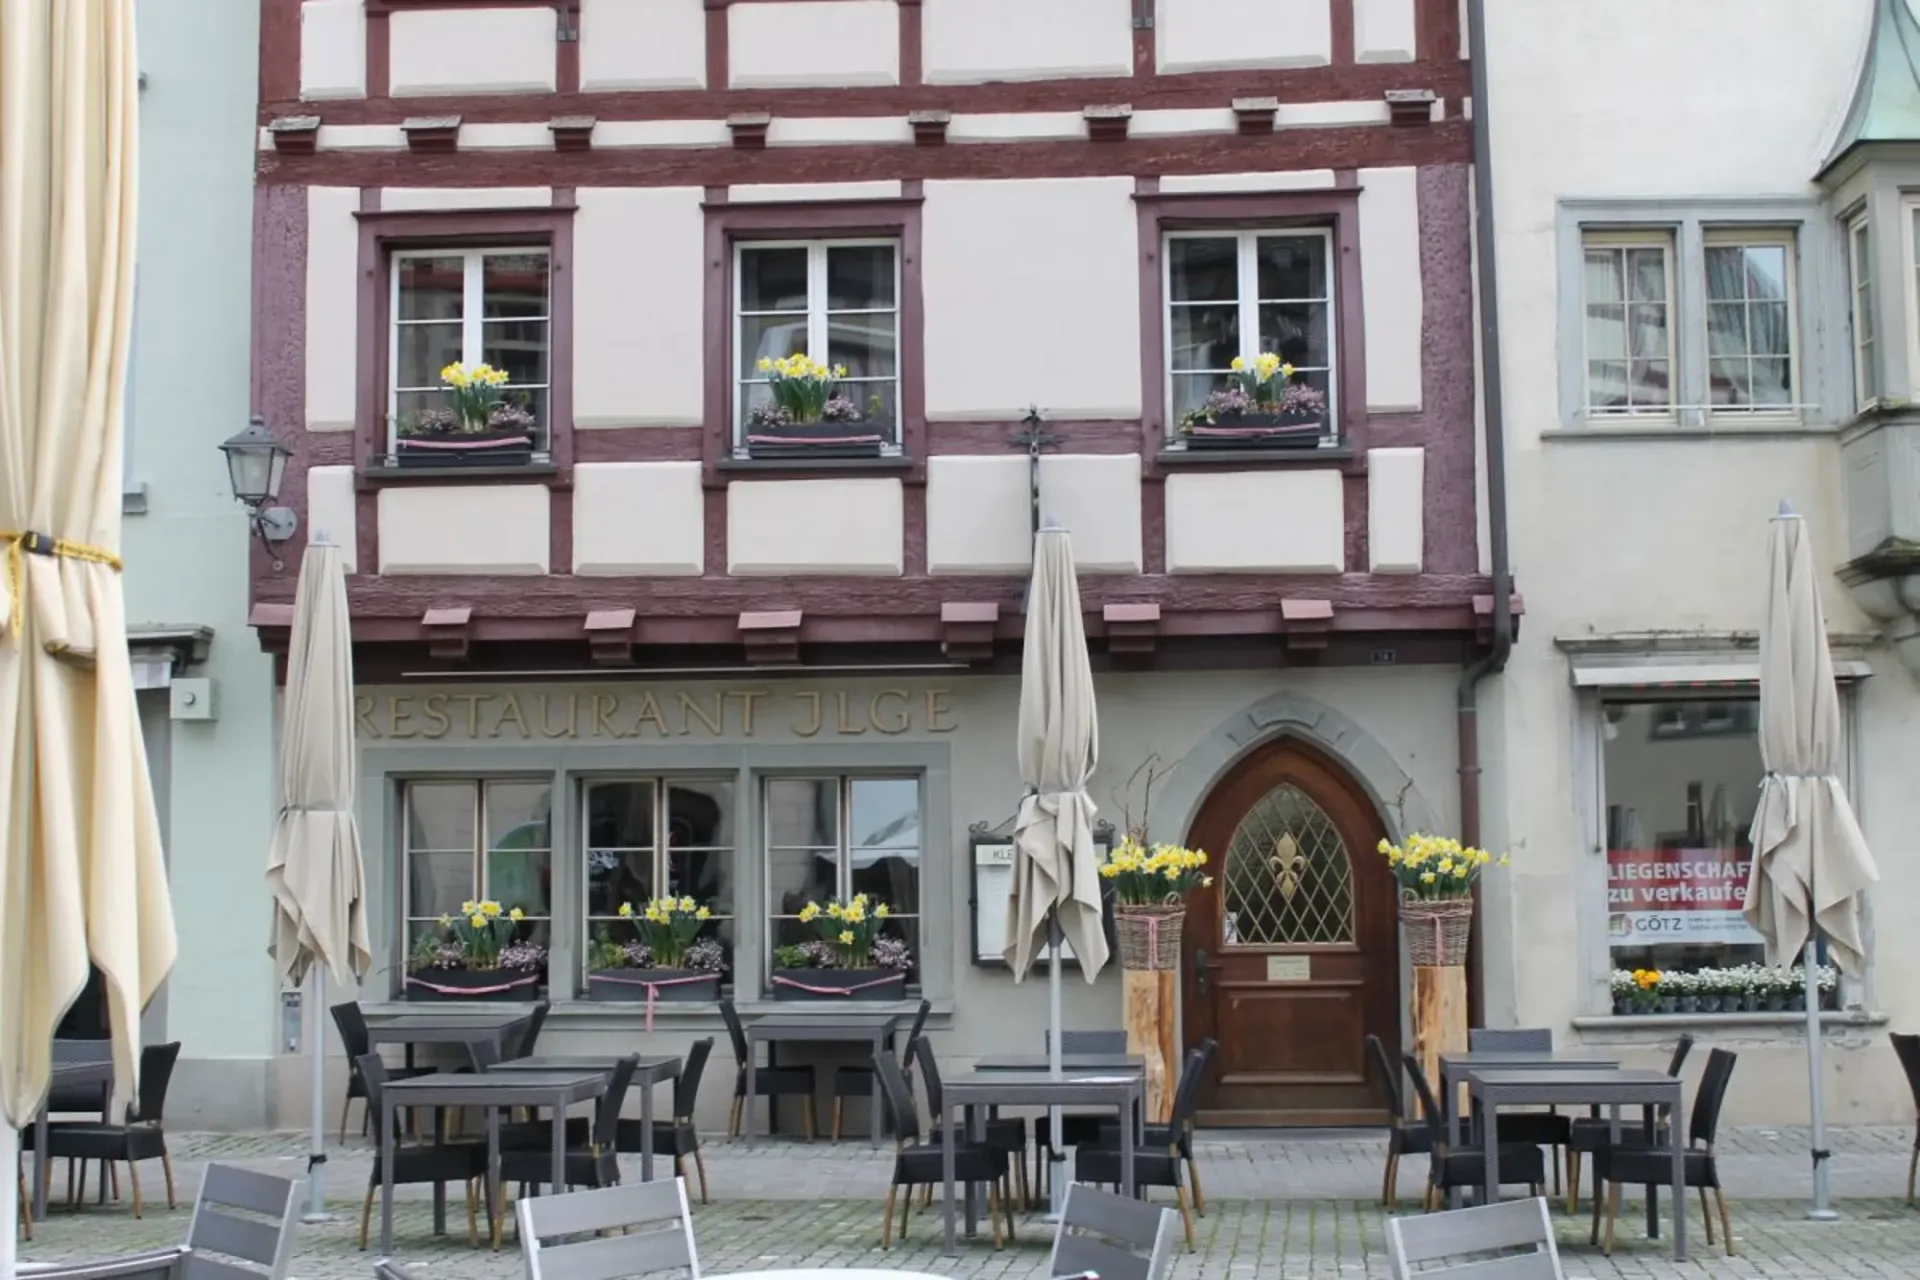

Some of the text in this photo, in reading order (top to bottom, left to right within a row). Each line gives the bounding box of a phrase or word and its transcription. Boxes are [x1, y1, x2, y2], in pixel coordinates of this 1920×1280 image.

[355, 690, 769, 739] RESTAURANT
[1608, 881, 1747, 902] zu verkaufe
[1635, 914, 1683, 932] GÖTZ
